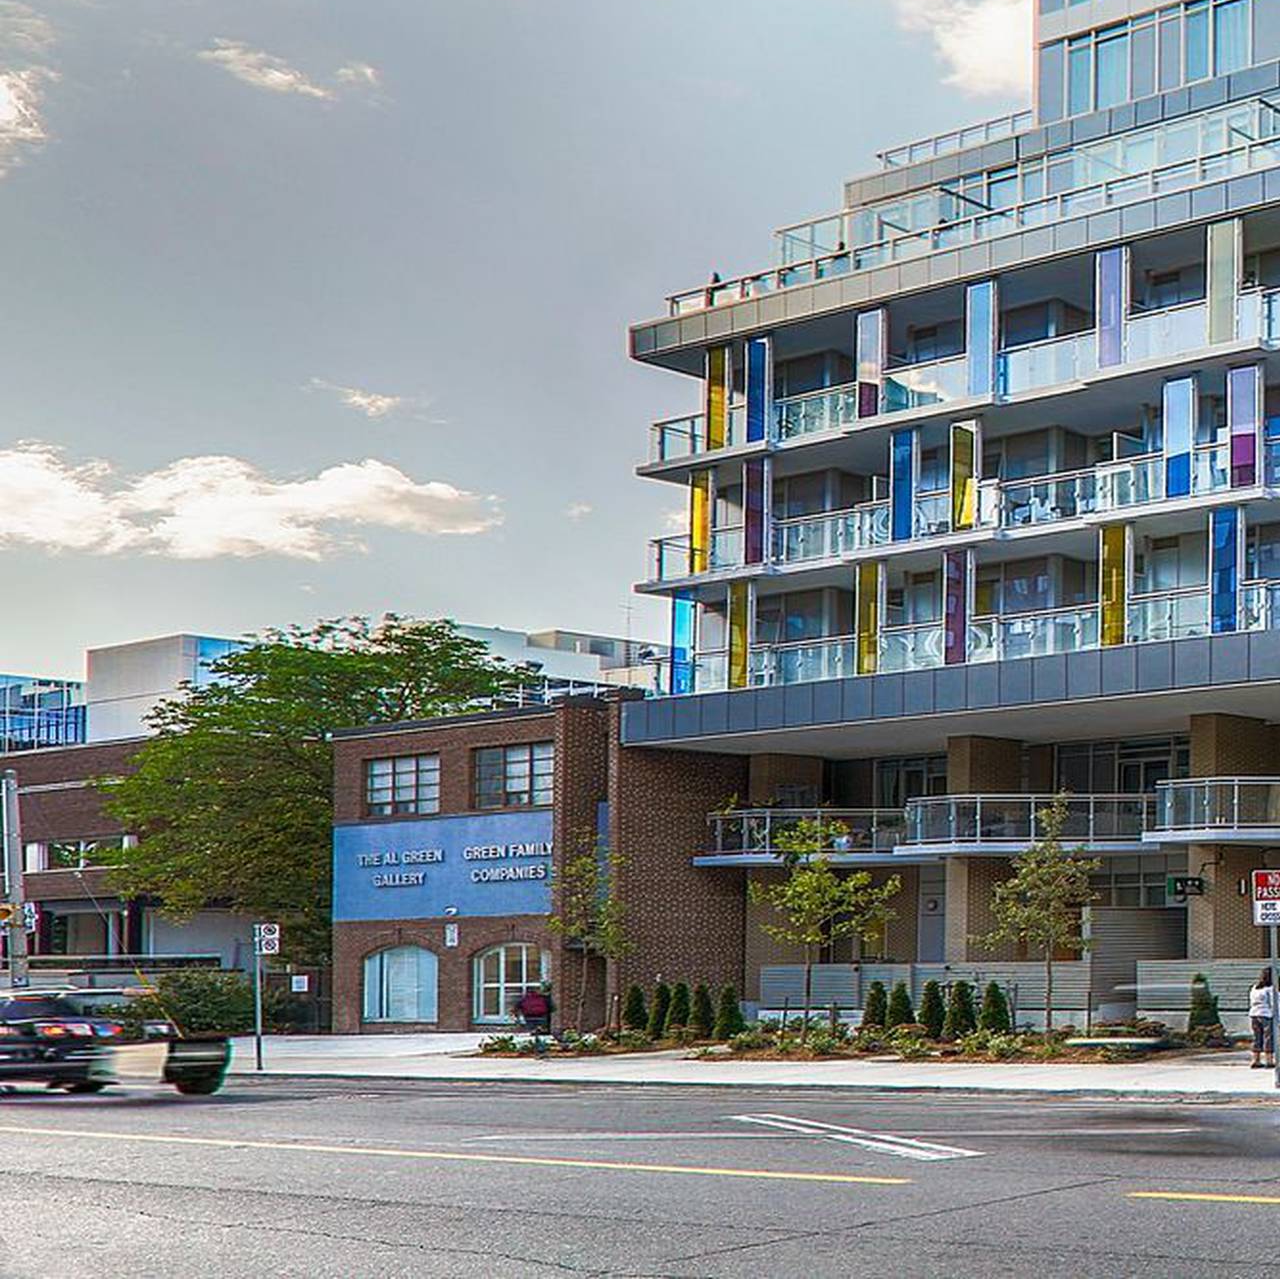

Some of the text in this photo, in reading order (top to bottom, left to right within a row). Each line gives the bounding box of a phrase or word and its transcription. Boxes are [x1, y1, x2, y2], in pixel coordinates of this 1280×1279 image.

[357, 849, 443, 867] THE AL GREEN
[463, 841, 553, 860] GREEN FAMILY
[372, 872, 426, 888] GALLERY
[471, 865, 546, 883] COMPANIES
